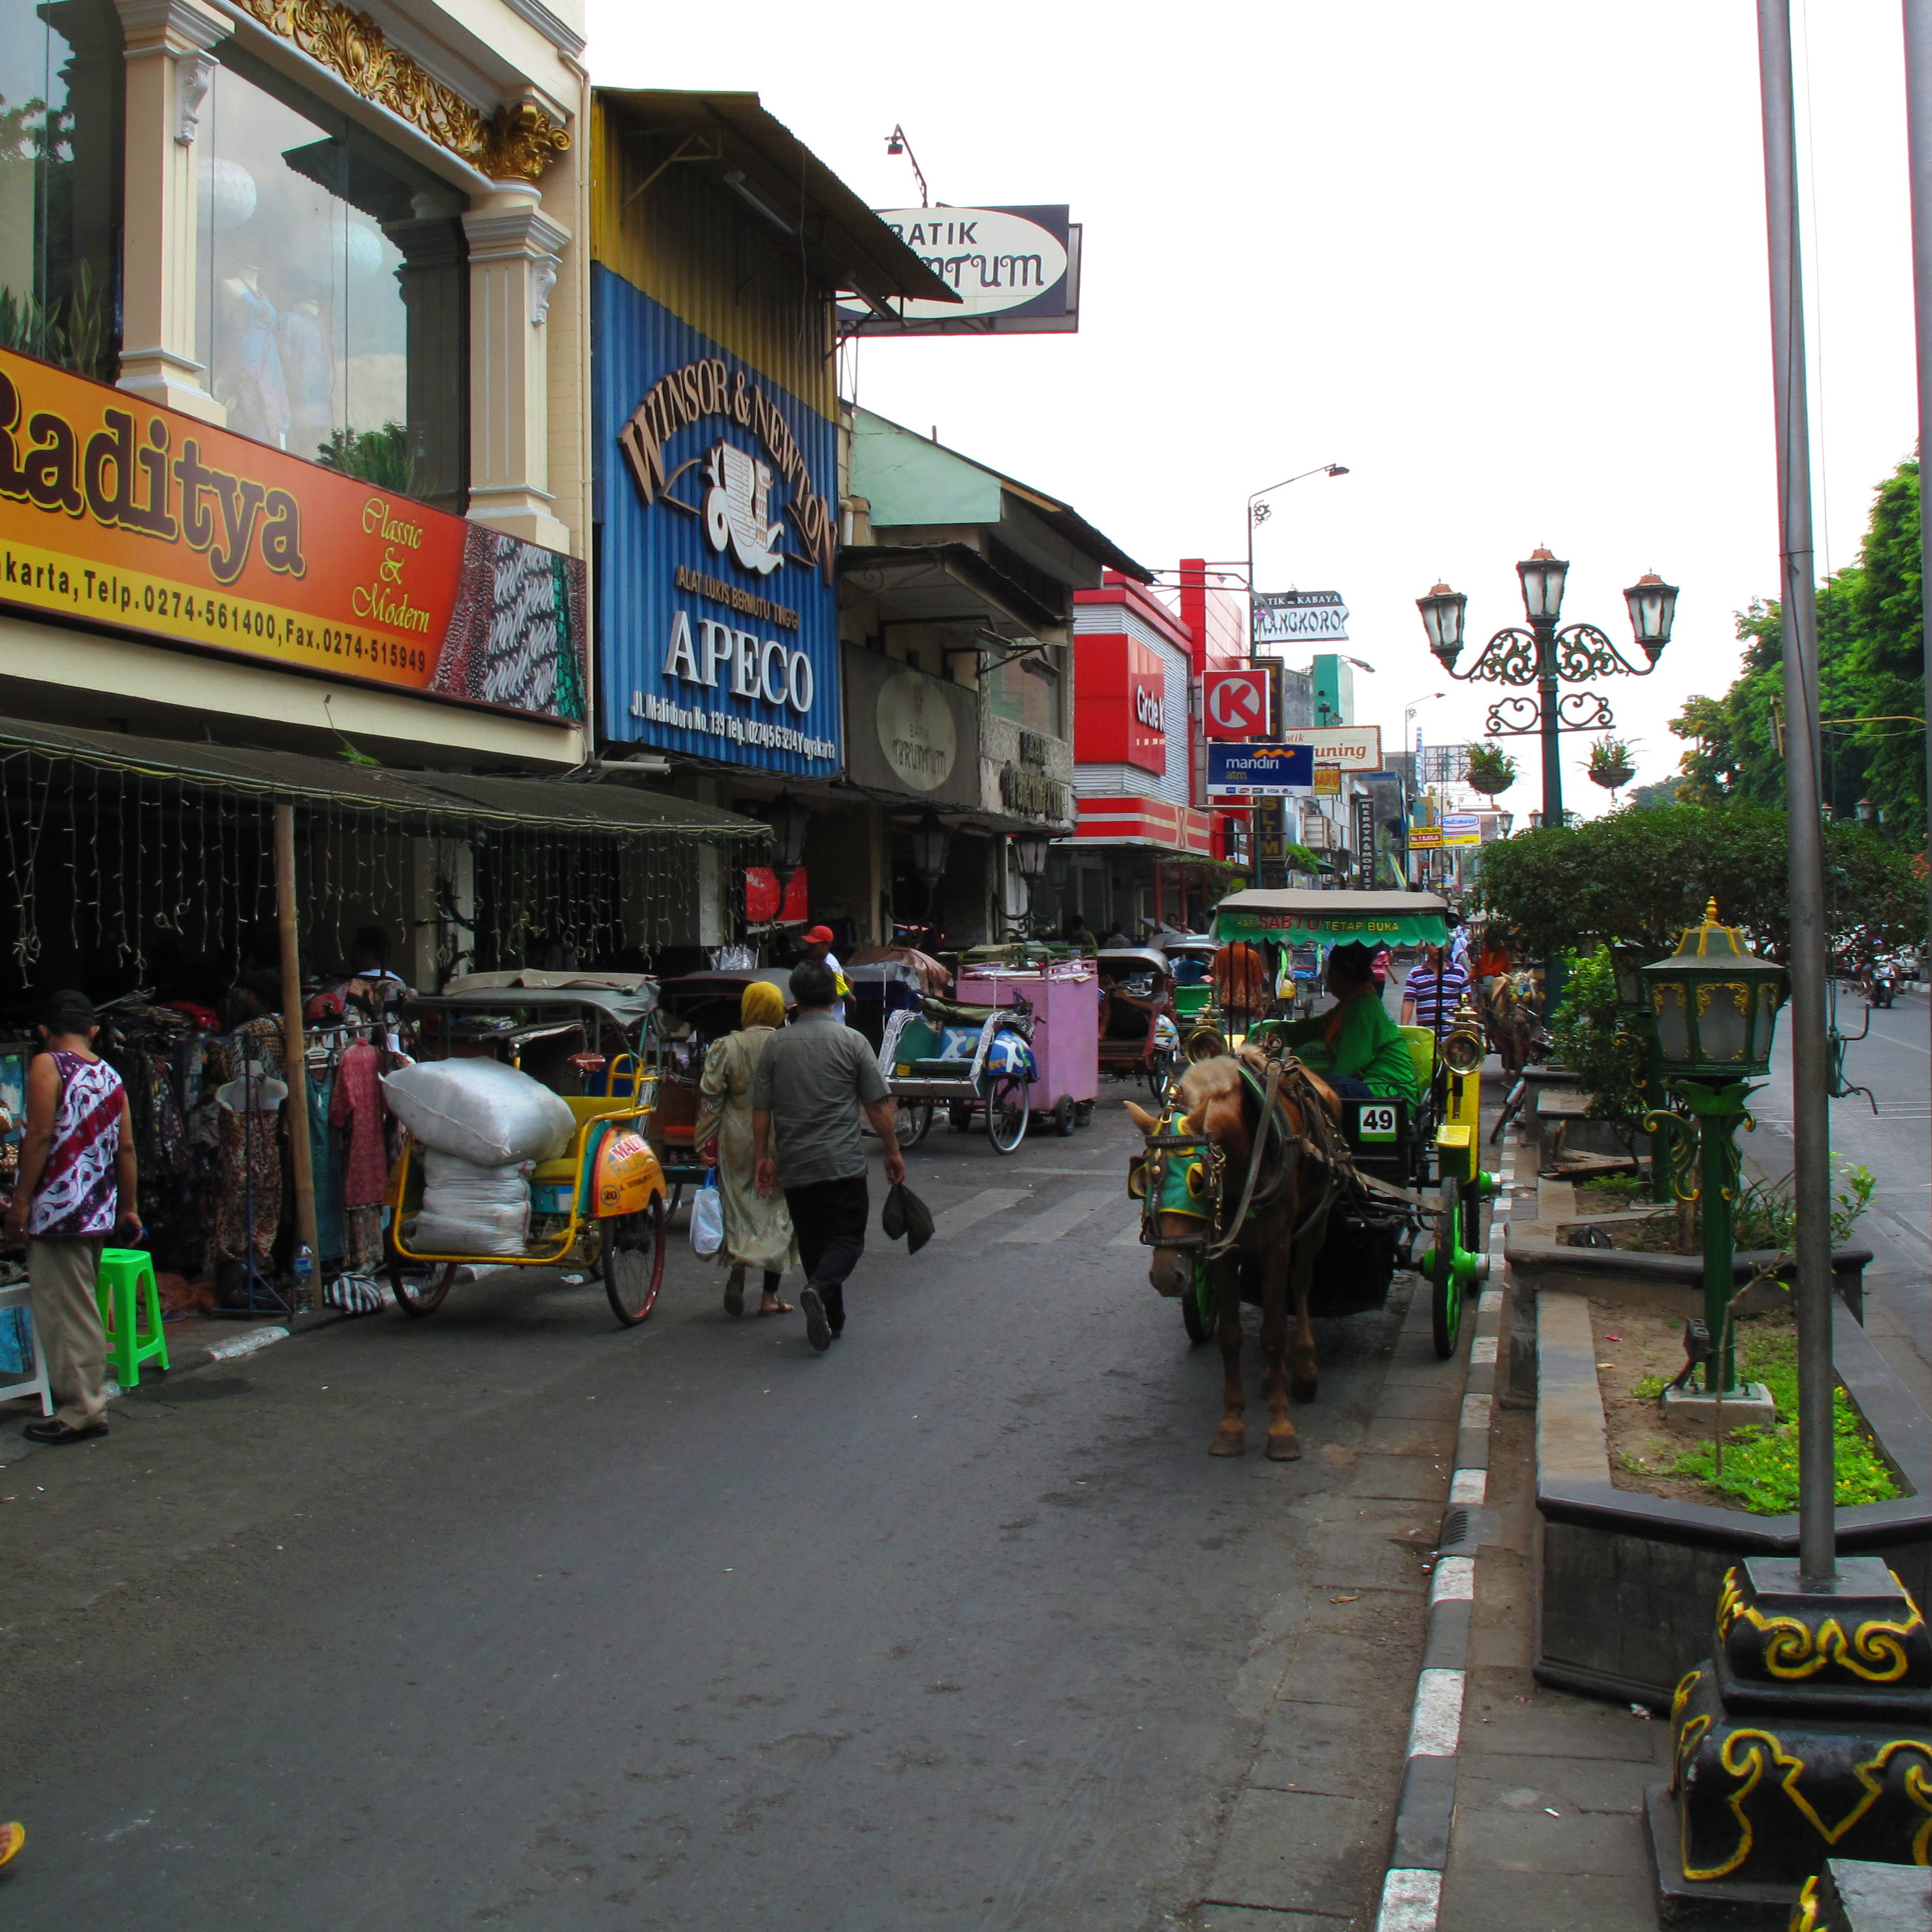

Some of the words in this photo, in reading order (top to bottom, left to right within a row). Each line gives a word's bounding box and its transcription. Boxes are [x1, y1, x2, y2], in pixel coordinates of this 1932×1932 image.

[617, 358, 731, 505] WINSOR
[735, 370, 751, 426] &
[751, 384, 838, 586] NEWTON
[362, 498, 422, 550] Classic
[379, 547, 405, 585] &
[676, 565, 702, 592] ALAT
[705, 575, 730, 605] LUKIS
[731, 586, 770, 620] BERMUTU
[1297, 595, 1339, 605] KABAYA
[352, 583, 430, 634] Modern
[662, 610, 814, 713] APECO
[631, 690, 645, 716] Jl.
[645, 693, 693, 729] Malioboro
[693, 706, 709, 733] No.
[709, 710, 725, 736] 139
[1284, 734, 1305, 742] atik
[1314, 743, 1367, 759] uning
[1226, 756, 1279, 769] mandiri
[1226, 771, 1248, 780] atm
[1258, 914, 1321, 931] SABTU
[1324, 921, 1363, 932] TETAP
[1367, 921, 1399, 932] BUKA
[1363, 1109, 1394, 1131] 49
[603, 1190, 617, 1200] 20
